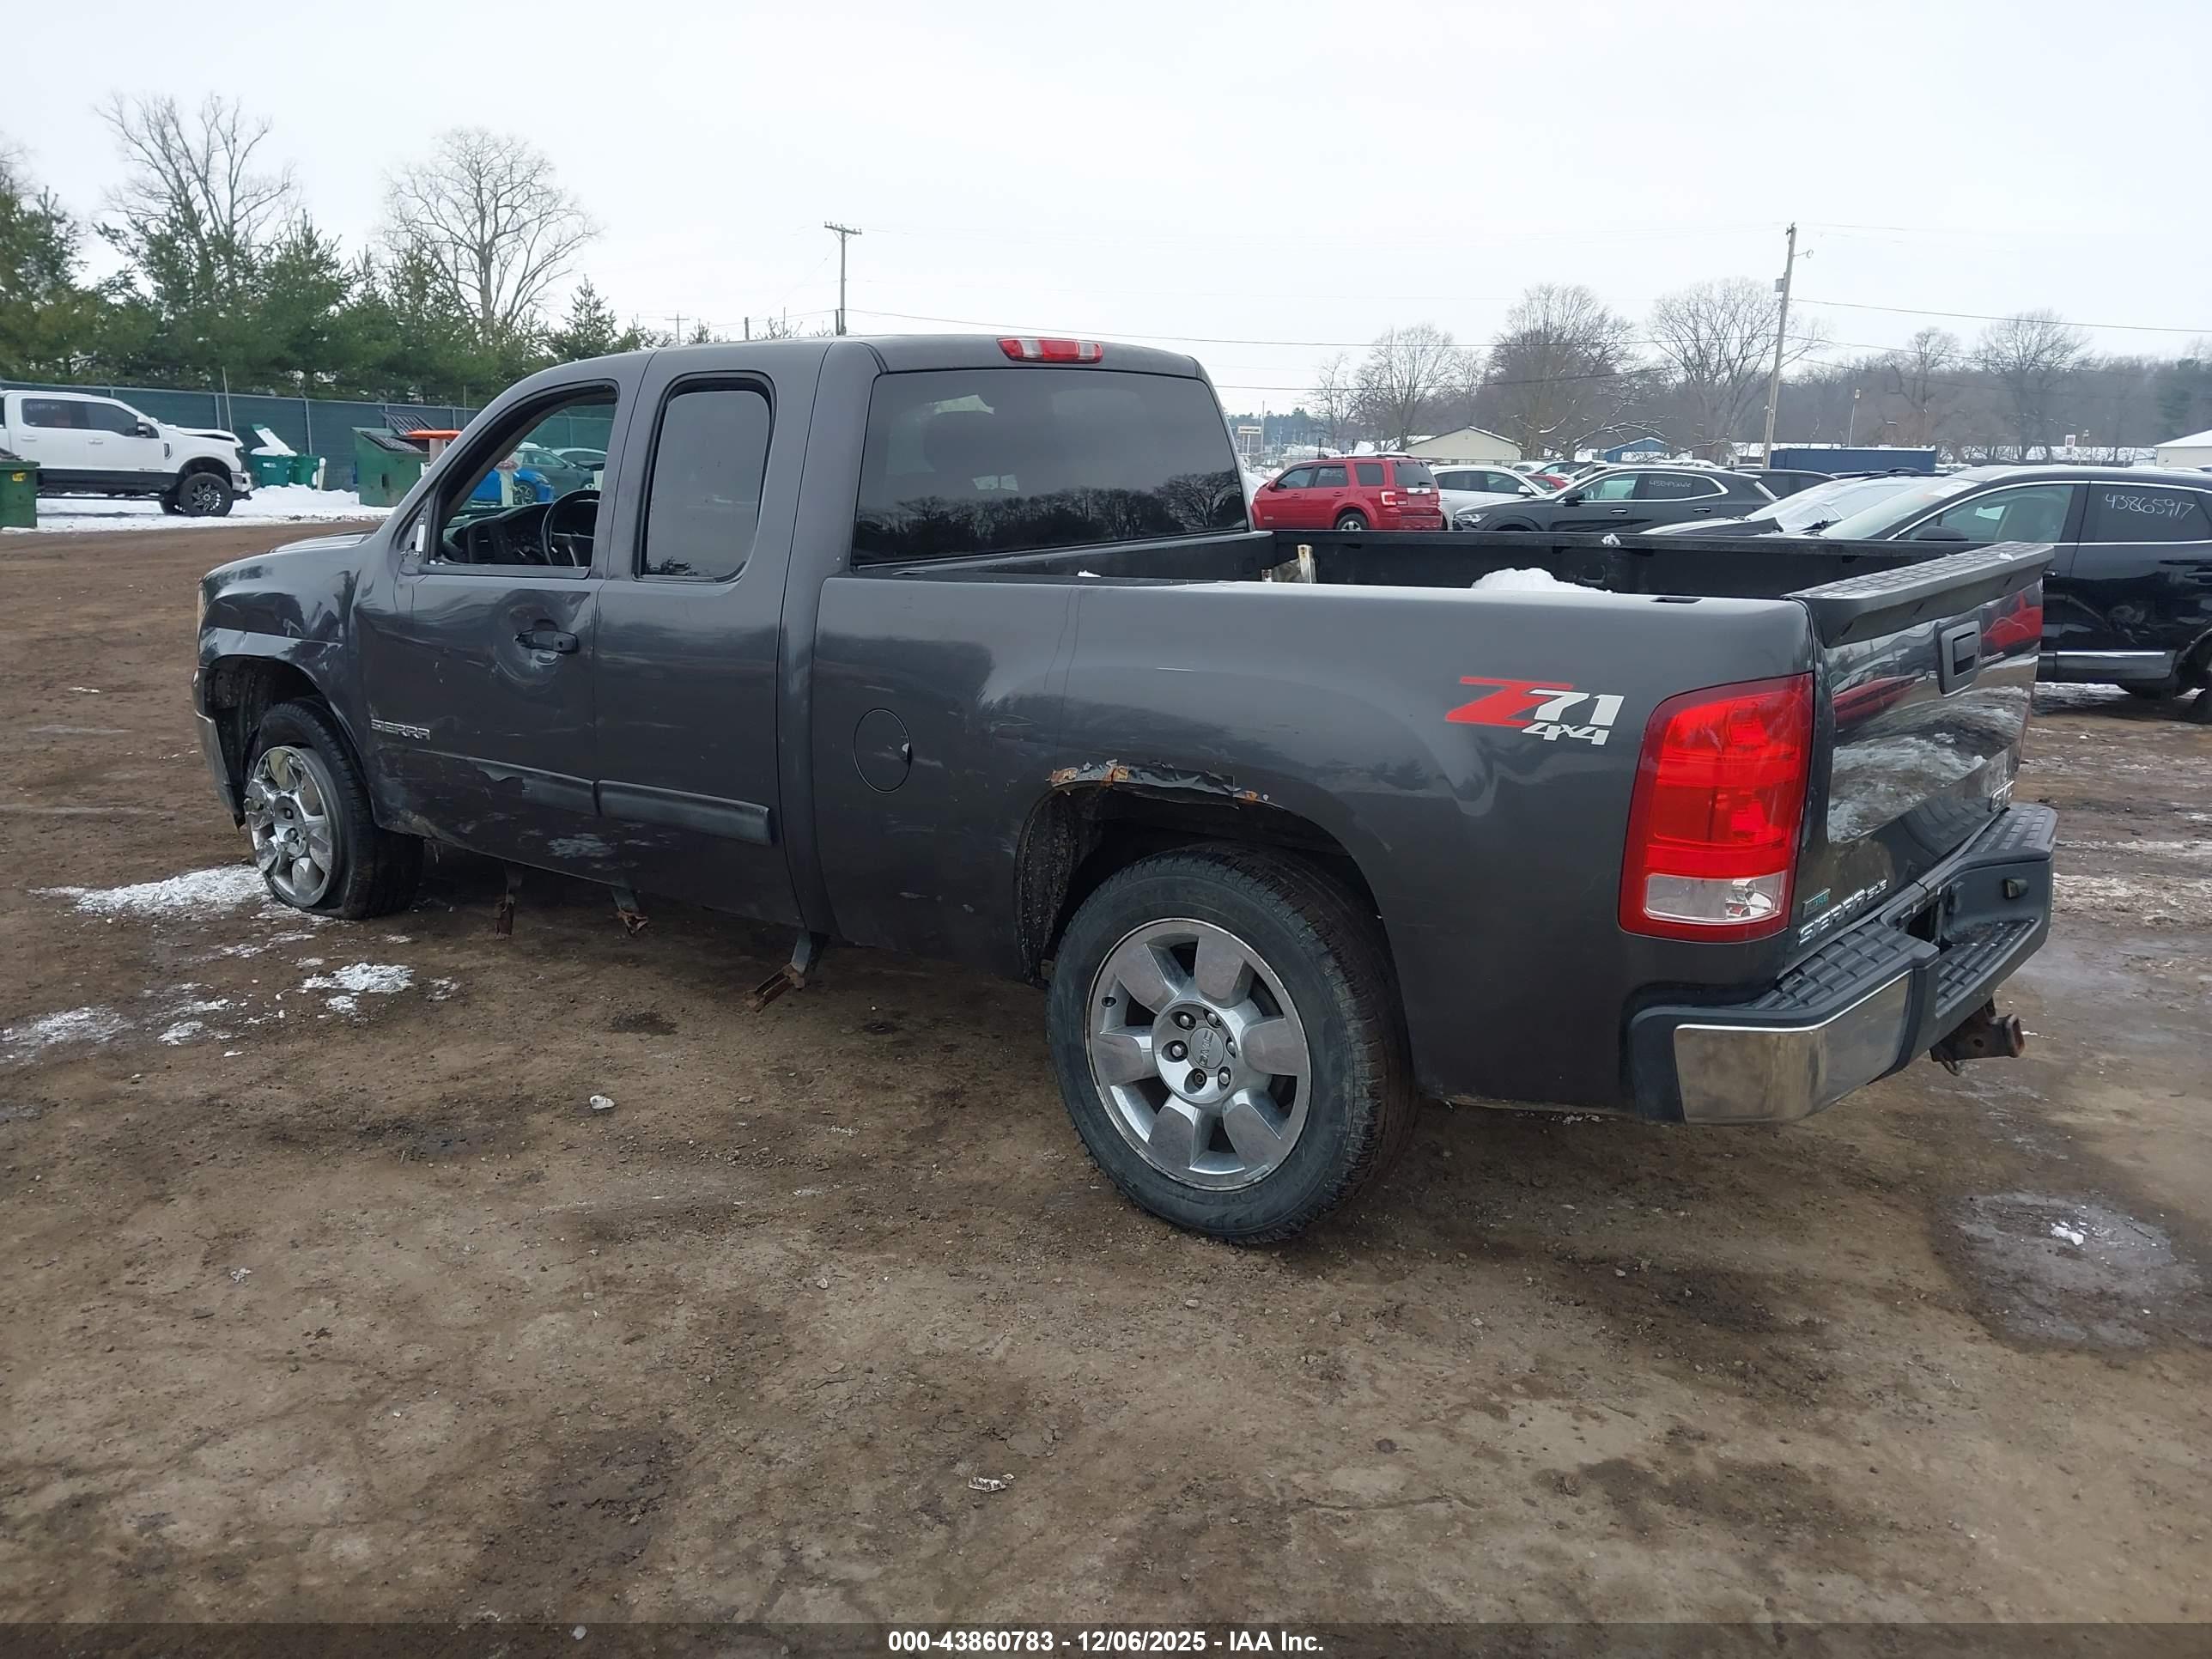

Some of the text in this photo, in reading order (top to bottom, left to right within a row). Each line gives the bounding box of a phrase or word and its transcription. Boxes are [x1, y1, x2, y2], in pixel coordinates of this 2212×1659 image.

[2105, 493, 2196, 520] 43865917
[1445, 677, 1625, 727] Z71
[370, 719, 431, 740] SIERRA
[1199, 1030, 1214, 1066] GMC
